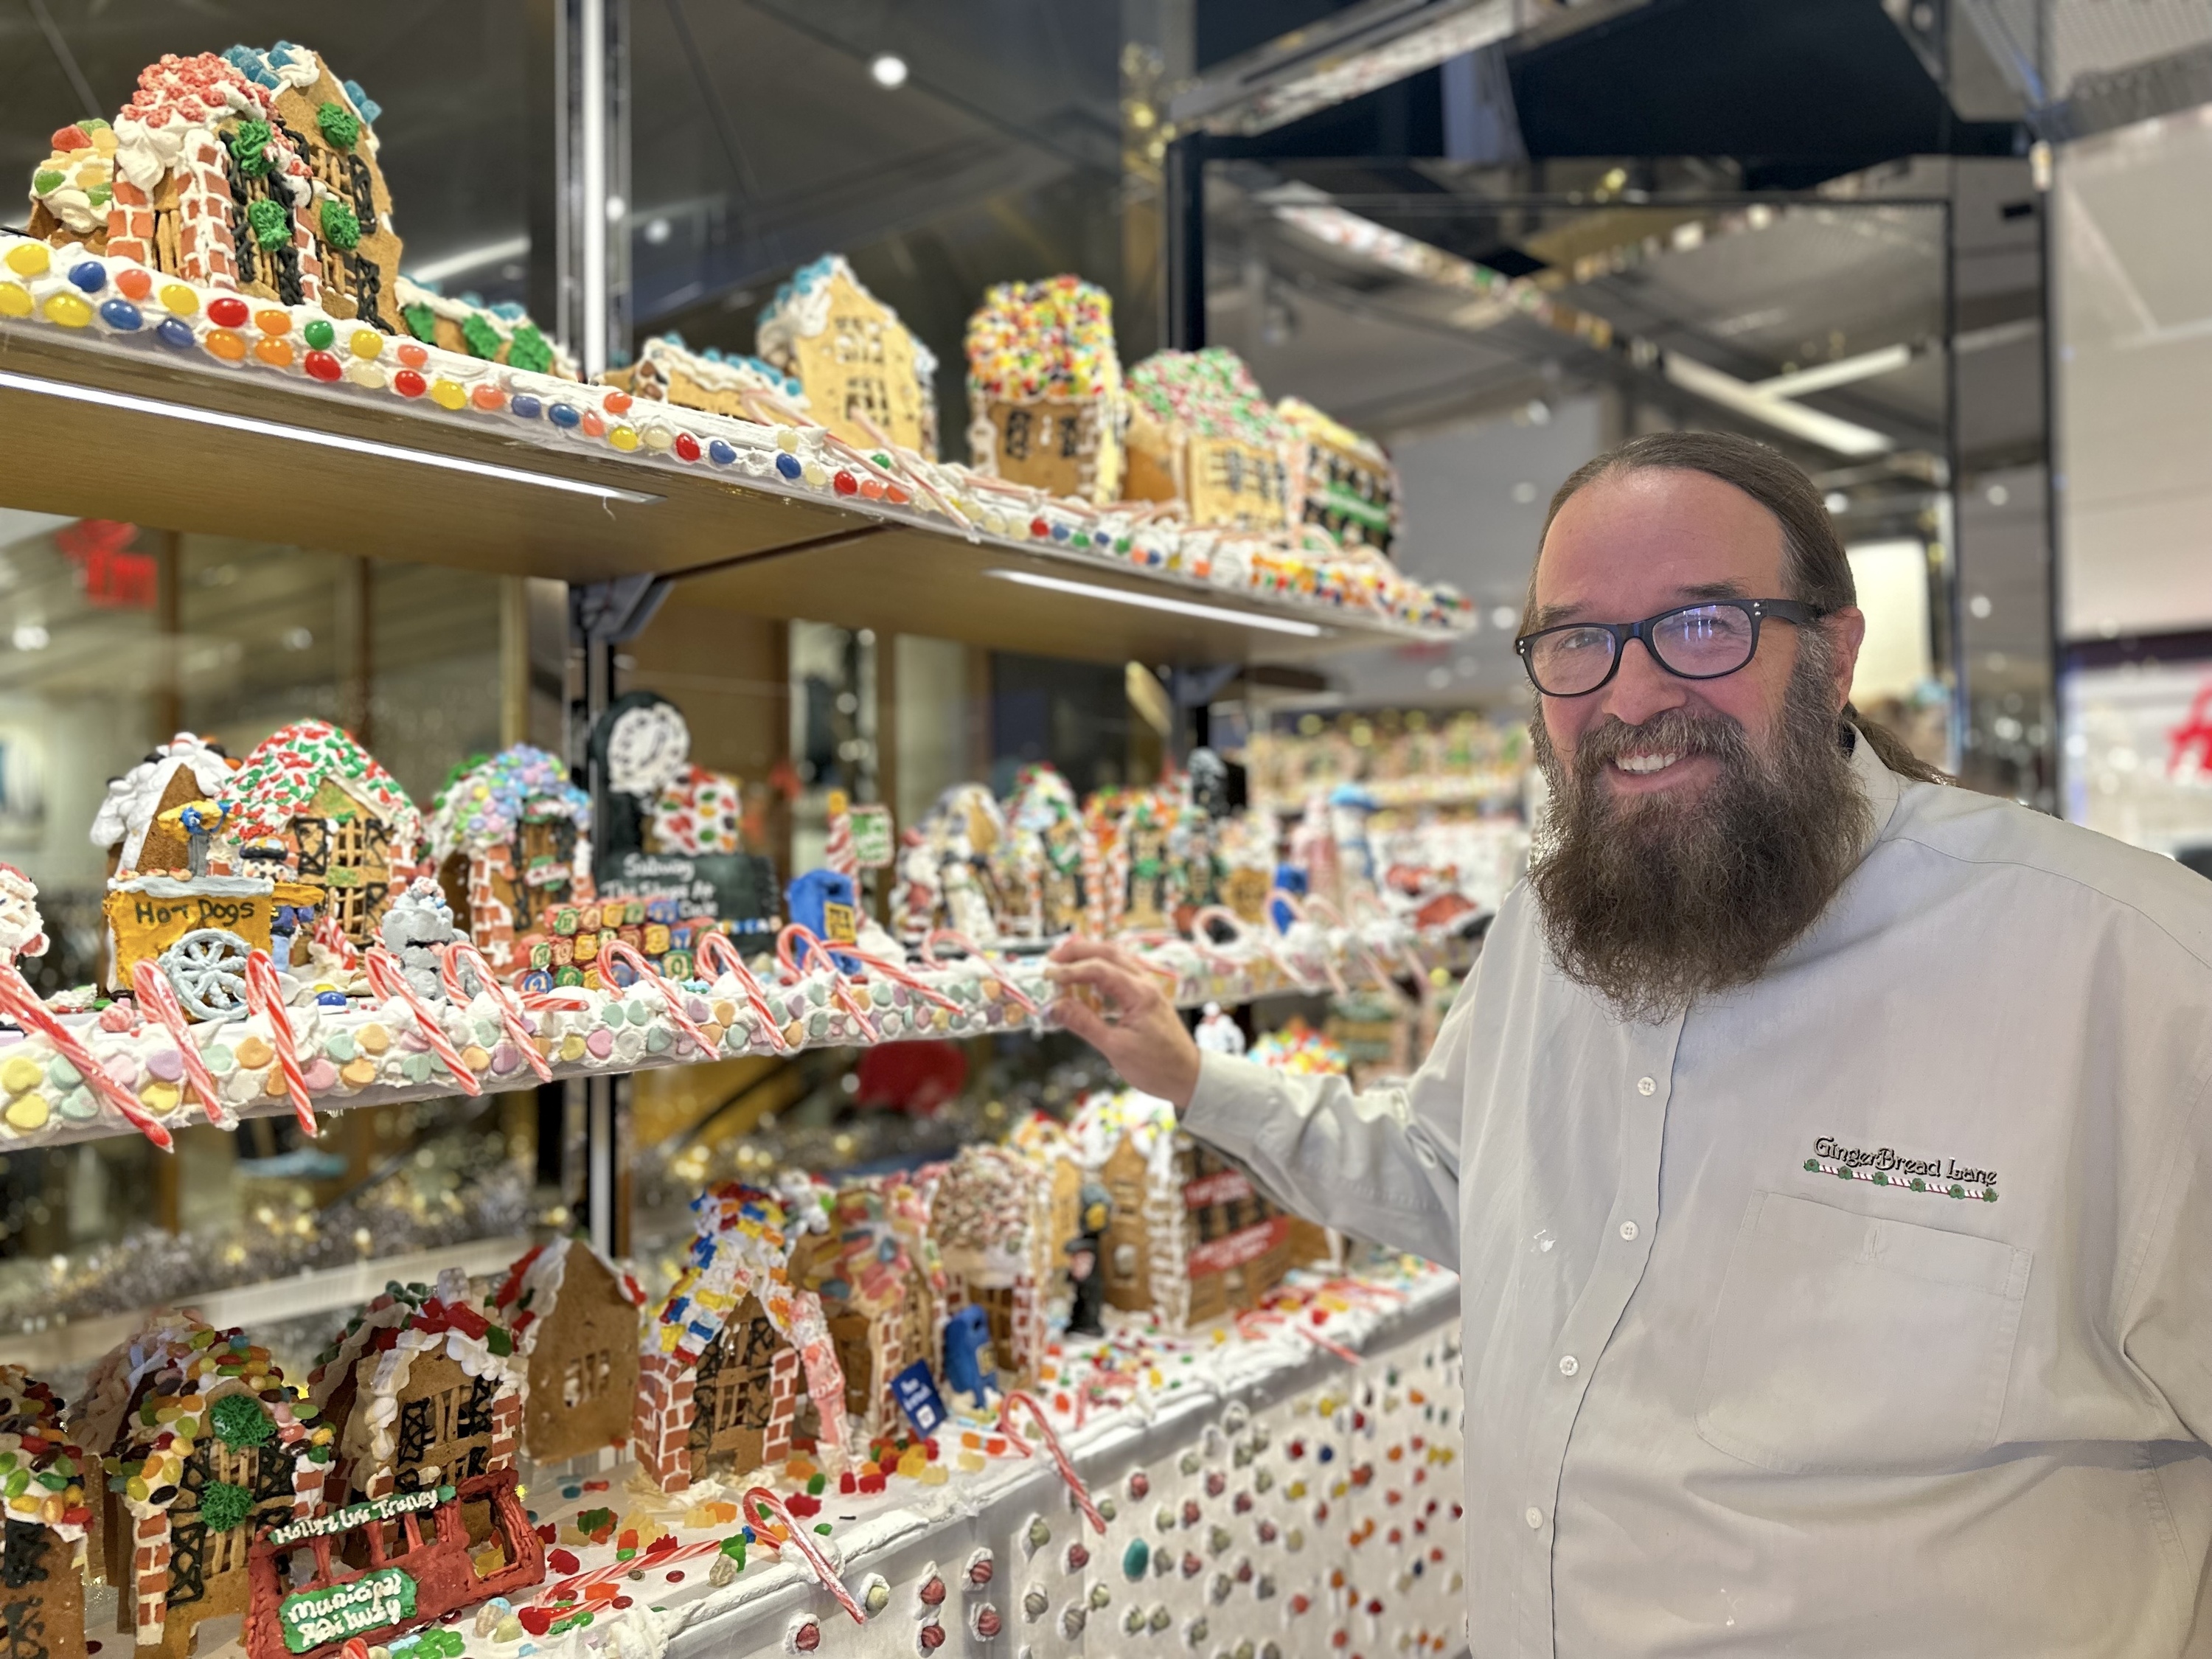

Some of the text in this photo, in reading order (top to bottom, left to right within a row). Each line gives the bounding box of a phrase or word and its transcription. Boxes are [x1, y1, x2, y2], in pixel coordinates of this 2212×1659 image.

[623, 852, 695, 883] Subway
[1946, 1156, 1998, 1186] Lane
[287, 1573, 403, 1624] Municipal
